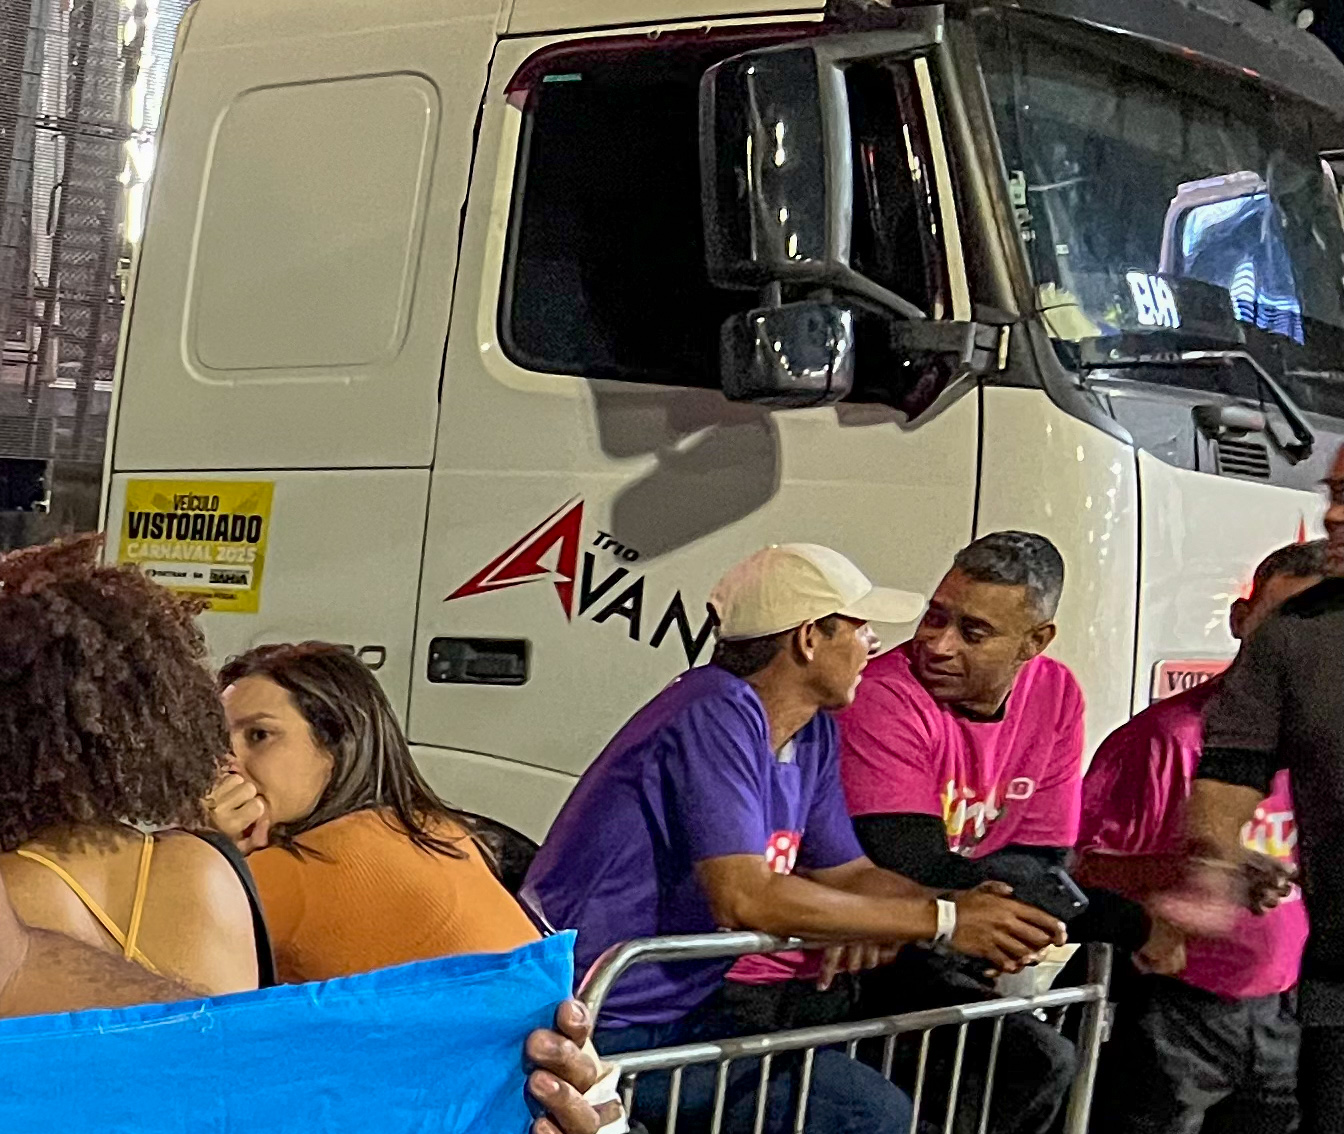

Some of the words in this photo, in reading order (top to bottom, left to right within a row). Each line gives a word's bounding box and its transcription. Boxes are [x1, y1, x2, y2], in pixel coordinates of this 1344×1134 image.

[128, 511, 263, 543] VISTORIADO
[127, 542, 212, 562] CARNAVAL
[216, 545, 258, 563] 2025
[443, 492, 720, 668] AVAN
